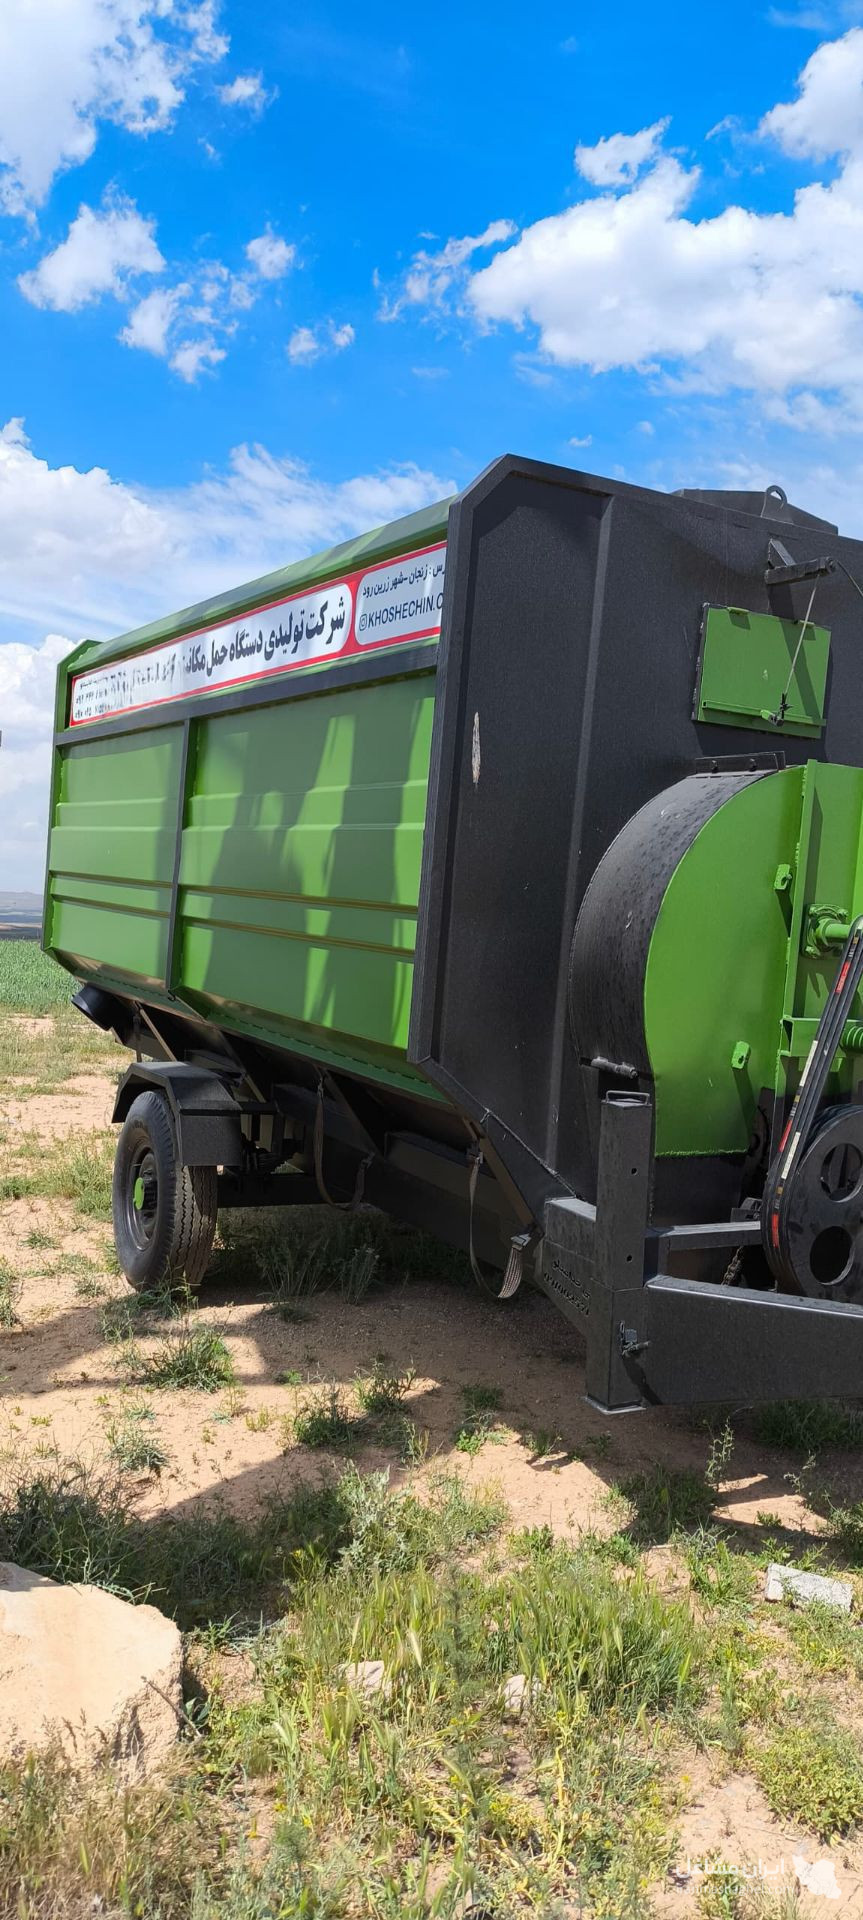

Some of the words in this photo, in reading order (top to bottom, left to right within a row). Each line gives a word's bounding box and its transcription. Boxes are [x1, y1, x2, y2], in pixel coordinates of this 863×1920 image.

[374, 577, 390, 596] زرین
[409, 564, 428, 585] زنجان
[362, 586, 374, 599] رود
[264, 609, 305, 661] تولیدی
[305, 597, 346, 645] شرکت
[206, 640, 228, 677] حمل
[229, 629, 264, 663] دستگاه
